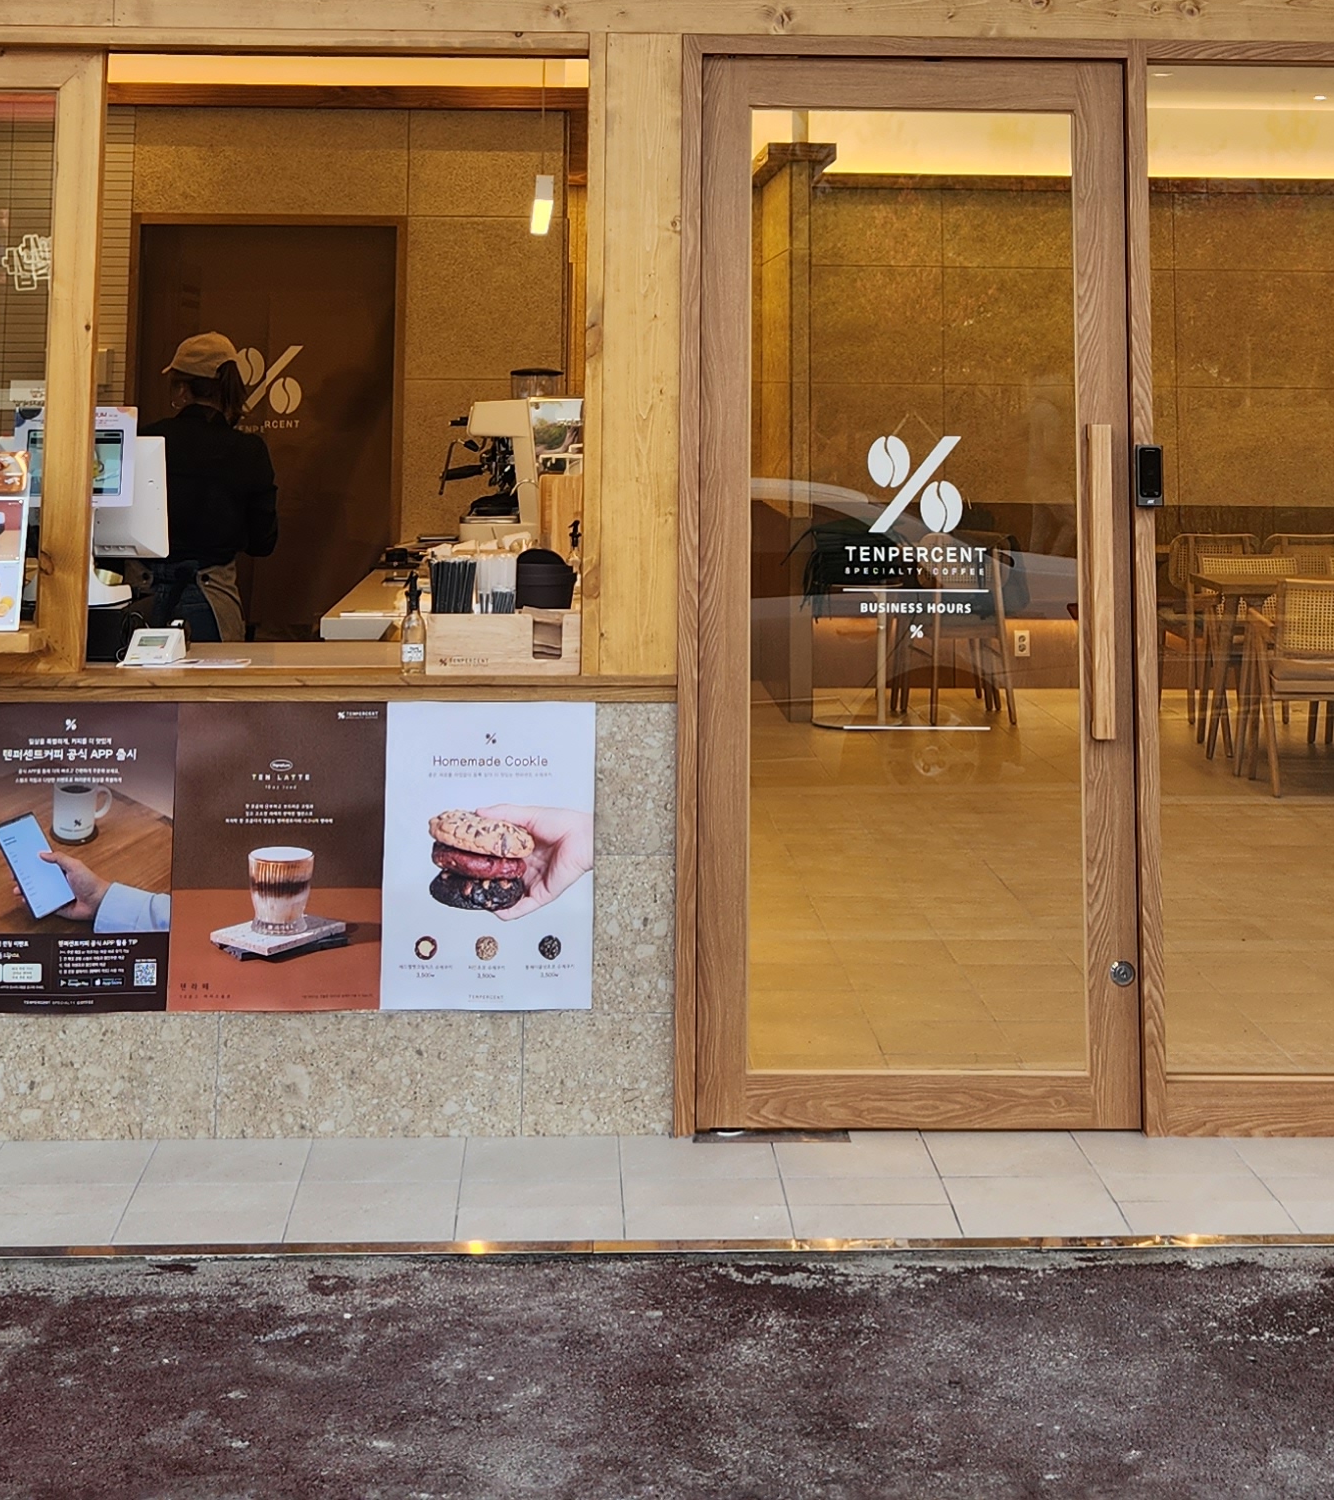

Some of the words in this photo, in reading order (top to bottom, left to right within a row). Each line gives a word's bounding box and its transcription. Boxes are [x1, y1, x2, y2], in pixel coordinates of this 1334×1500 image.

[844, 545, 987, 564] TENPERCENT
[844, 566, 923, 576] SPECIALTY
[932, 567, 985, 577] COFFEE
[860, 602, 924, 614] BUSINESS
[927, 602, 972, 614] HOURS
[2, 748, 64, 761] 텐퍼센트커피
[67, 748, 88, 761] 공식
[90, 749, 114, 760] APP
[432, 755, 501, 767] Homemade
[504, 755, 549, 767] Cookie
[251, 773, 271, 781] TEN
[277, 773, 311, 781] LATTE
